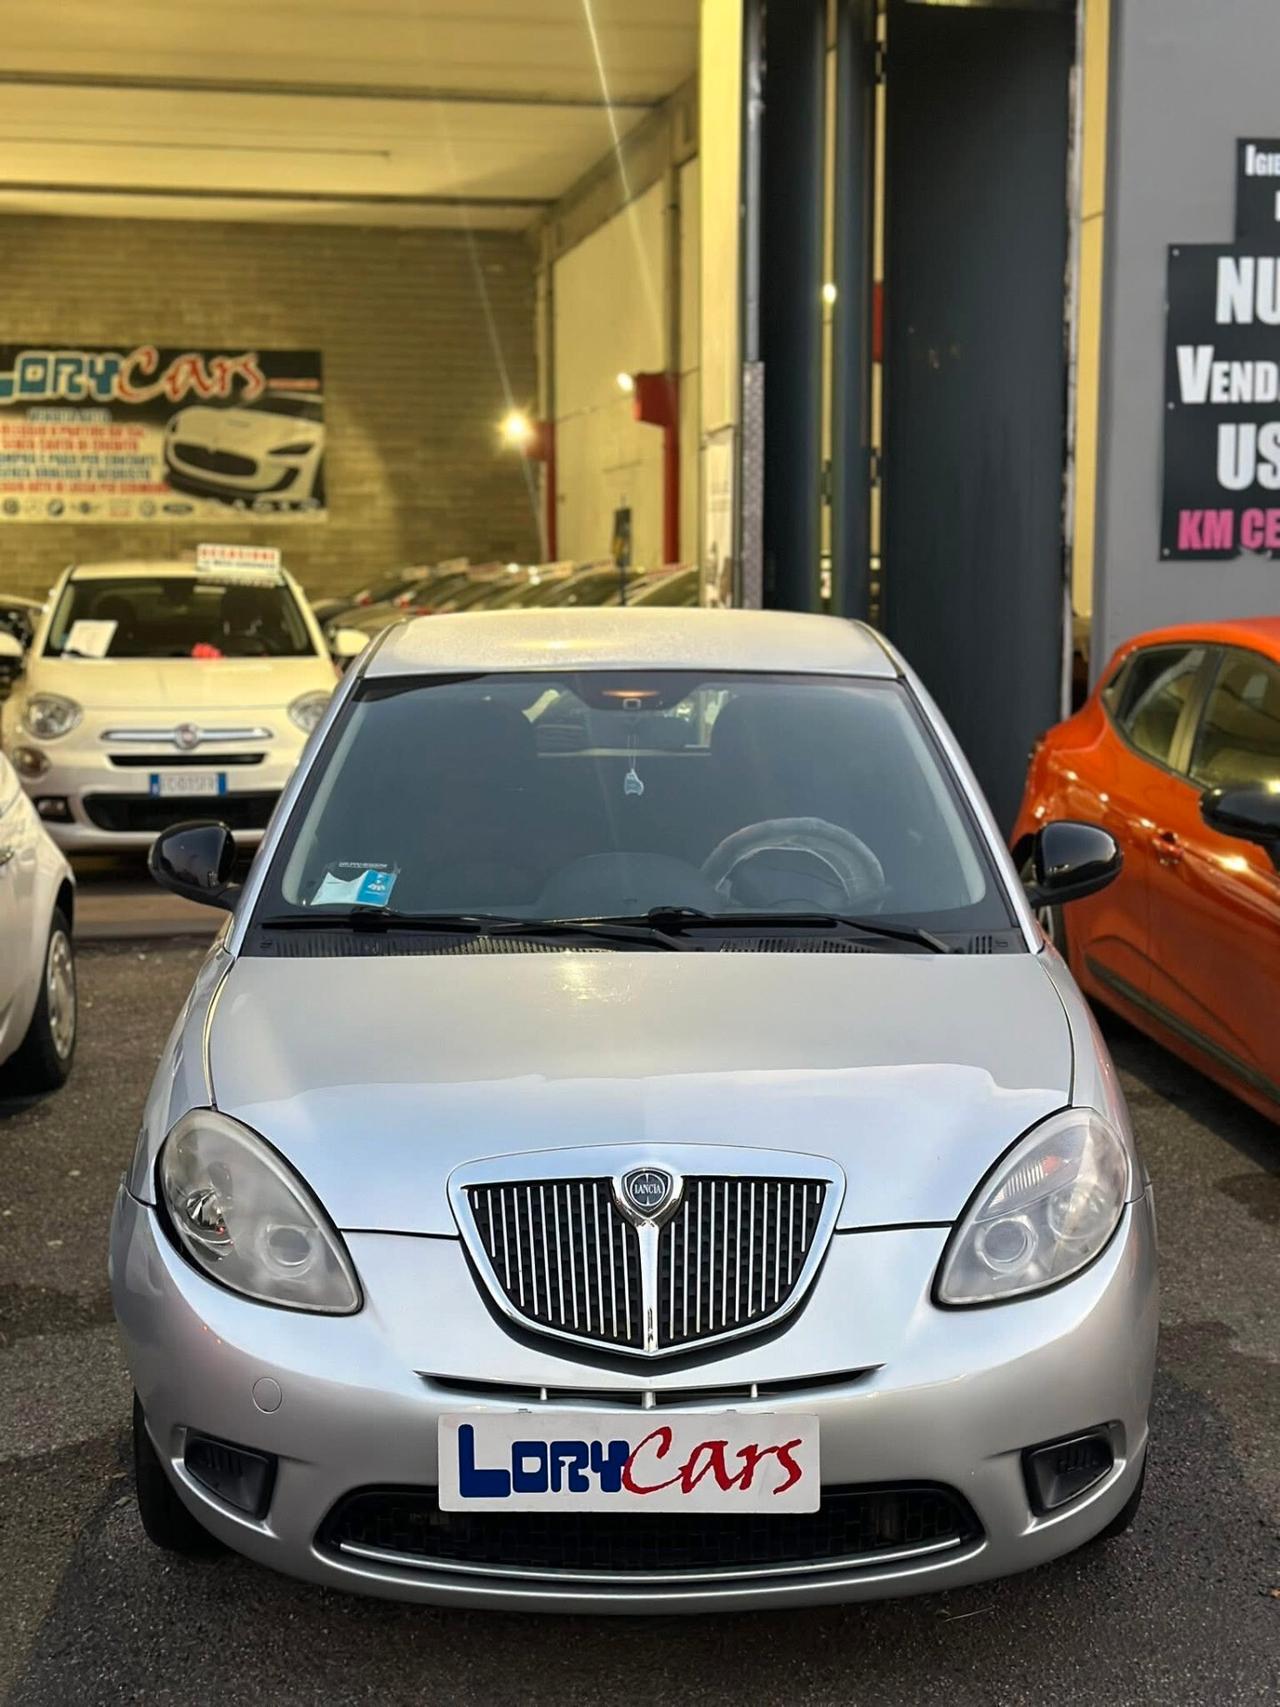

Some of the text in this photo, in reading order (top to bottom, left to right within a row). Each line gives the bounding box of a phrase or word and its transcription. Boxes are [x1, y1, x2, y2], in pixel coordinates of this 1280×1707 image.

[1215, 256, 1280, 325] NU
[1176, 345, 1280, 404] VEND
[1177, 508, 1234, 550] KM
[634, 1184, 662, 1195] LANCIA
